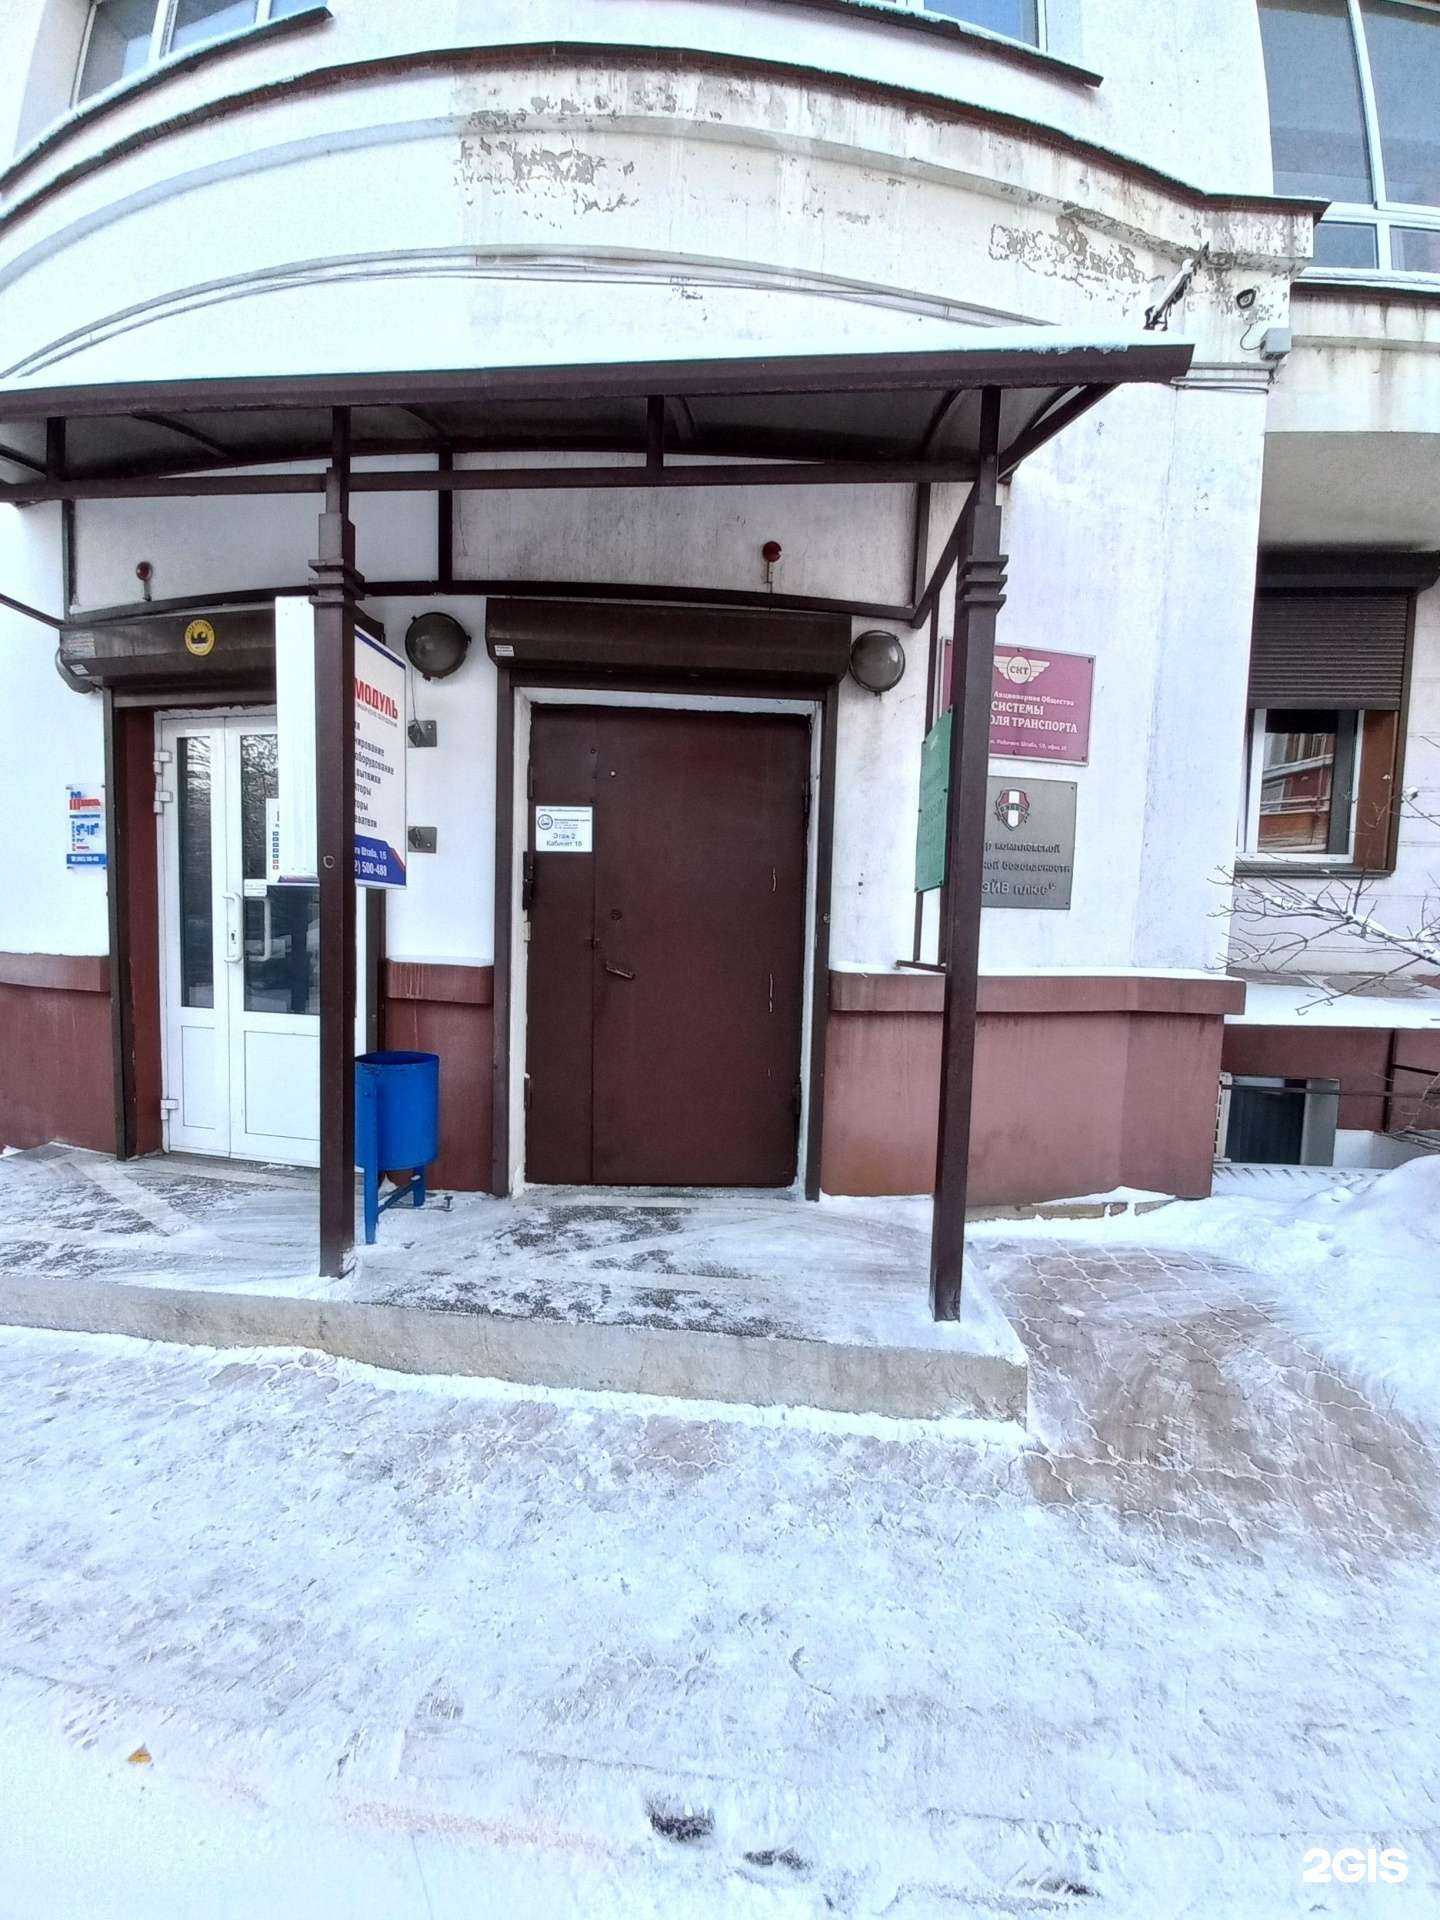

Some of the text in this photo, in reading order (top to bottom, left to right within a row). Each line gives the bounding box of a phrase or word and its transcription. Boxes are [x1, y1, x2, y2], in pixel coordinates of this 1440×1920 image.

[355, 677, 398, 720] МОДУЛЬ
[991, 700, 1044, 716] СИСТЕМЫ
[1011, 717, 1078, 733] ТРАНСПОРТА
